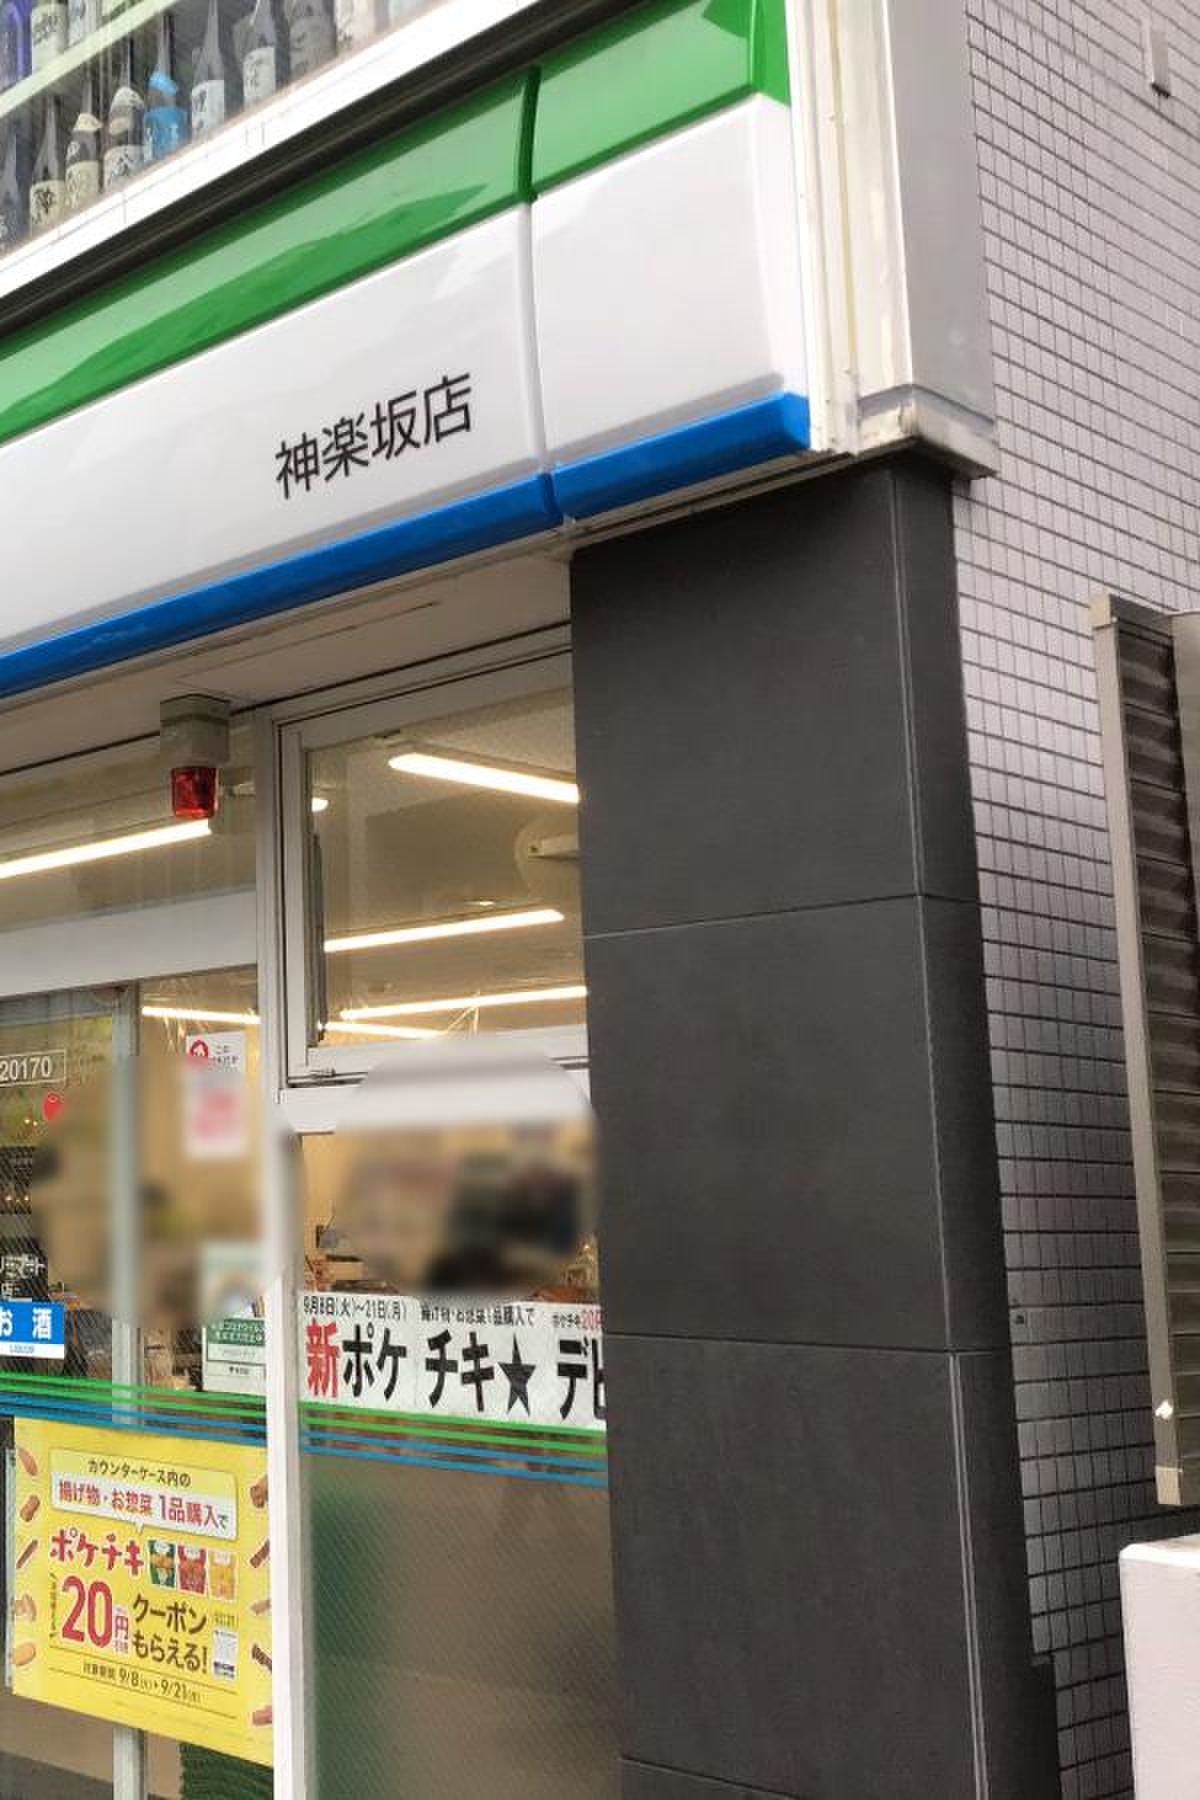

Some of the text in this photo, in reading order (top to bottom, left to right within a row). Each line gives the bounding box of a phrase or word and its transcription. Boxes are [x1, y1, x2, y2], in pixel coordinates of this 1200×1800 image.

[275, 373, 472, 500] 神楽坂店
[0, 1055, 53, 1081] 20170
[87, 1459, 192, 1488] カウンターケース内の
[49, 1527, 145, 1576] ポケチキ
[132, 1592, 207, 1635] クーポン
[132, 1630, 208, 1675] もらえる!
